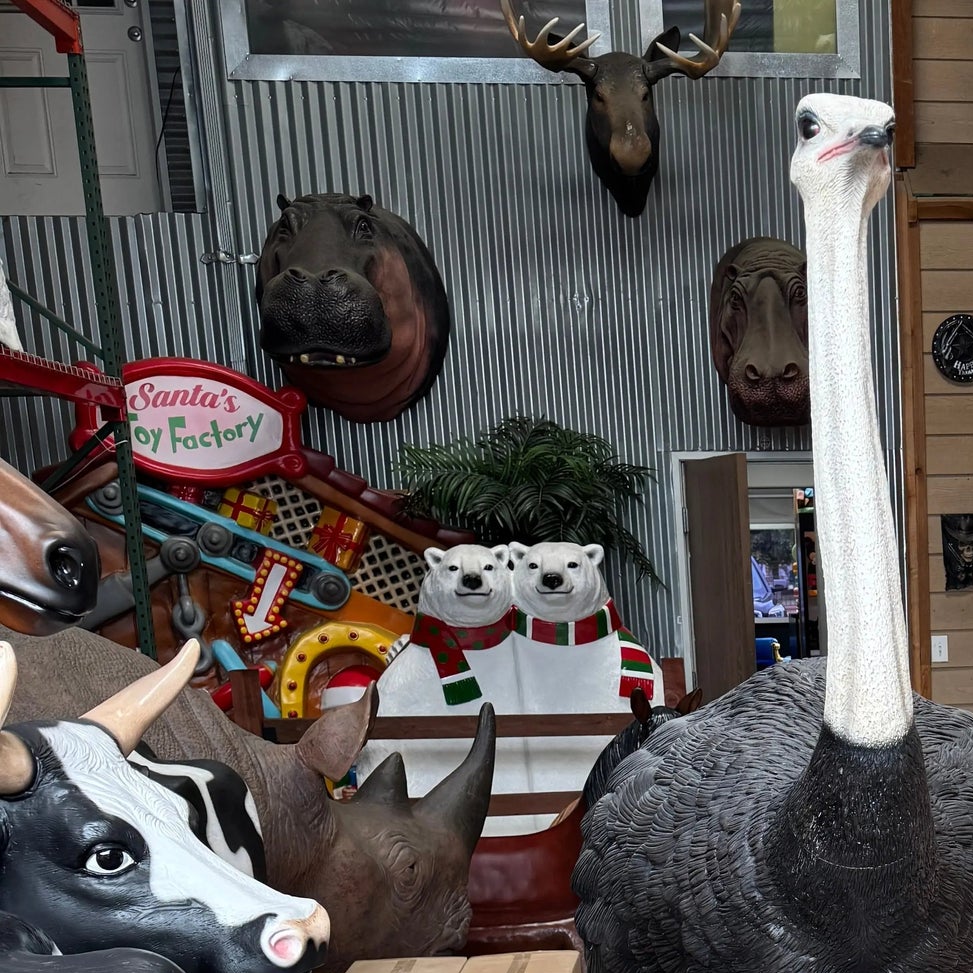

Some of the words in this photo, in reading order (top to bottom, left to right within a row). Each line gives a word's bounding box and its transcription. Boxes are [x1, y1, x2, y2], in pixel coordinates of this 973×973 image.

[128, 382, 241, 413] Santa's
[128, 412, 163, 454] oy
[168, 412, 264, 454] Factory
